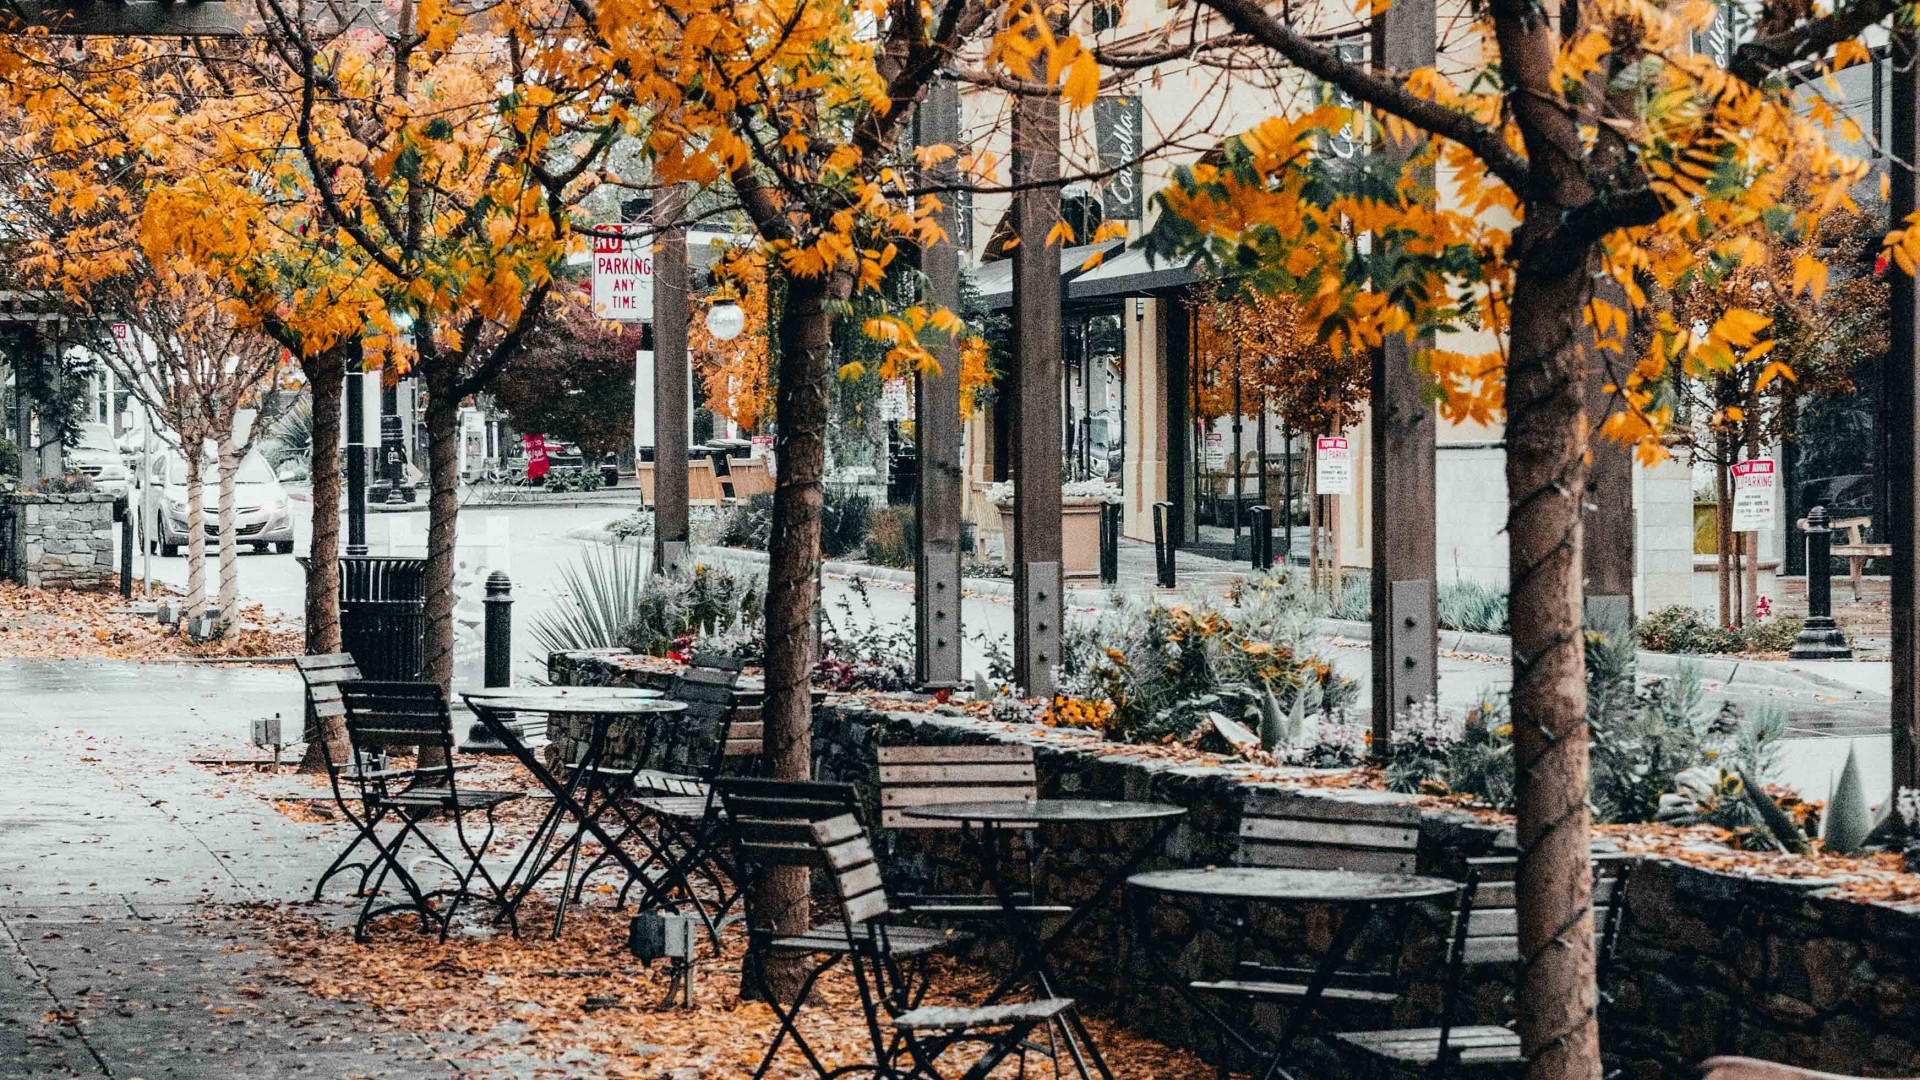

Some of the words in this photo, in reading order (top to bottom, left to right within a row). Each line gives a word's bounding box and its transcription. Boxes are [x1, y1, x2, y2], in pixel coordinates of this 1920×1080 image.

[596, 228, 619, 250] NO
[598, 258, 651, 275] PARKING
[613, 279, 635, 291] ANY
[612, 296, 636, 308] TIME
[1744, 475, 1772, 487] PARKING
